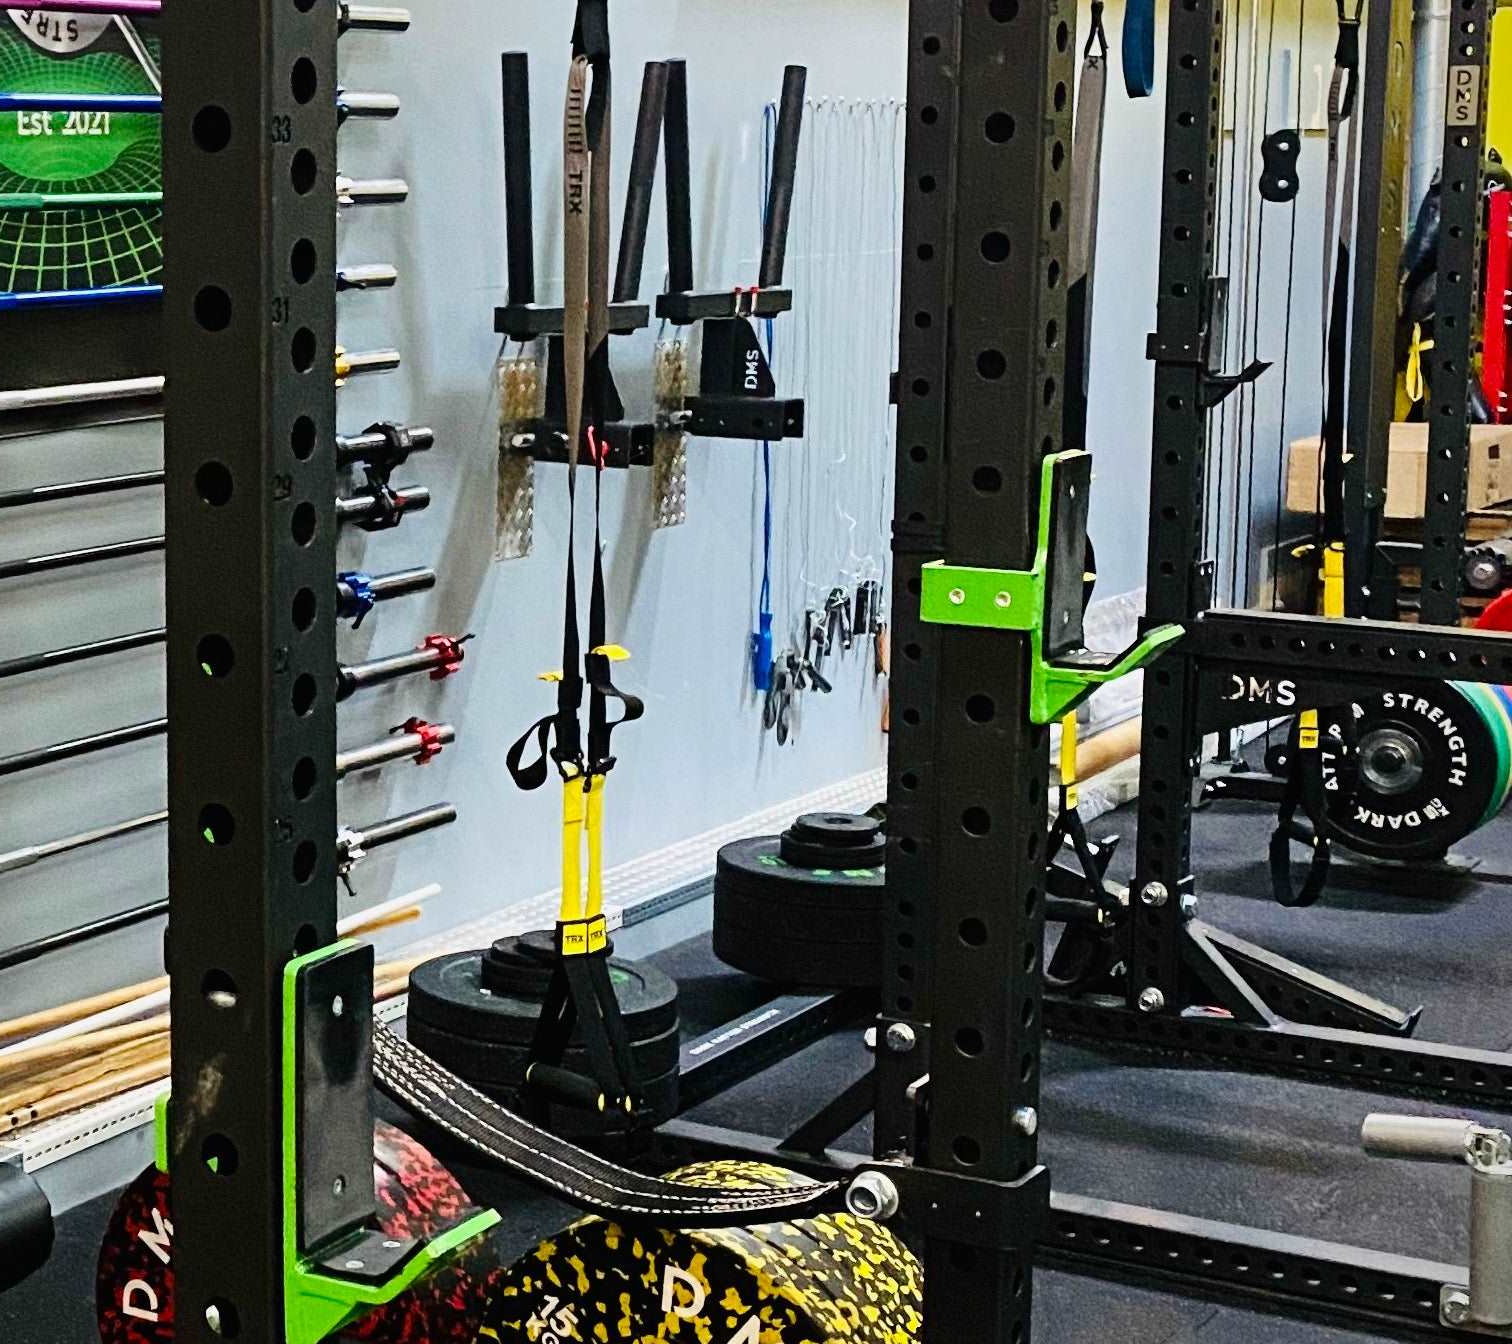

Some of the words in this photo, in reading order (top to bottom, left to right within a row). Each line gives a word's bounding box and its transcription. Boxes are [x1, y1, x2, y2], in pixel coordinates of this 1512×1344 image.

[1455, 69, 1472, 120] DMS
[16, 111, 53, 136] Est
[61, 111, 110, 136] 2021
[568, 170, 583, 216] TRX
[744, 348, 760, 390] DMS
[1382, 692, 1468, 787] STRENGTH
[1353, 805, 1422, 830] DARK
[122, 1207, 173, 1323] DM
[539, 1294, 579, 1338] 15
